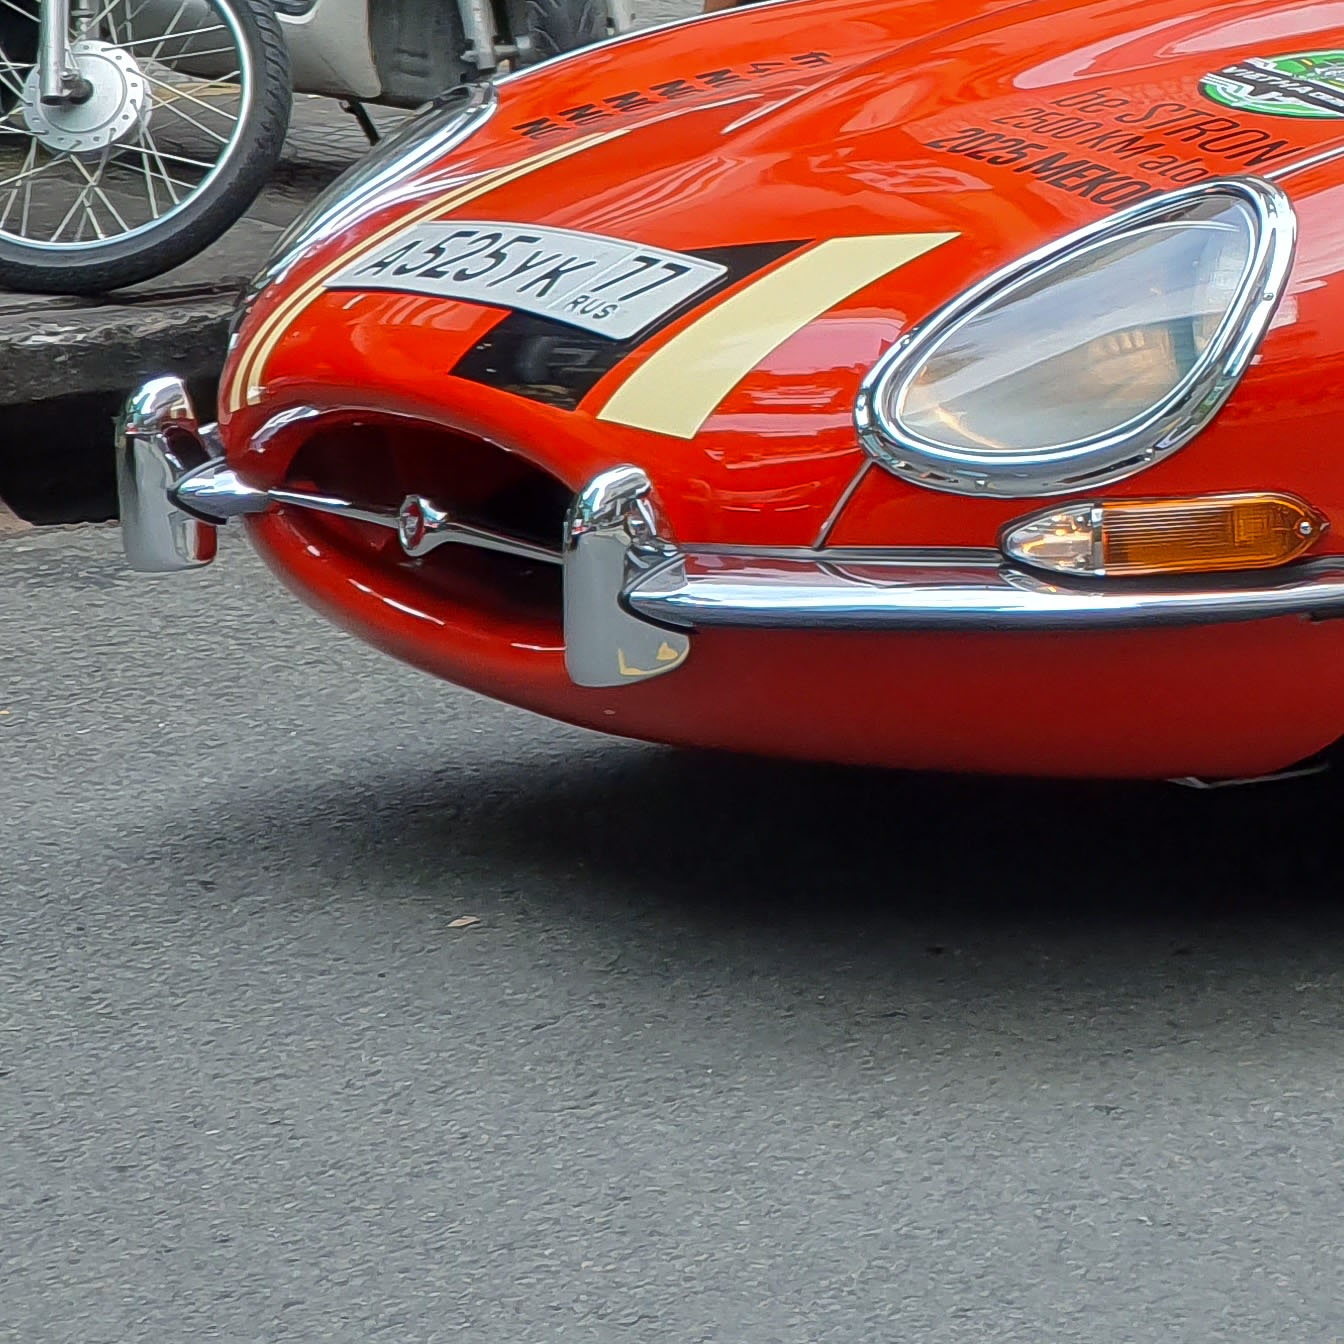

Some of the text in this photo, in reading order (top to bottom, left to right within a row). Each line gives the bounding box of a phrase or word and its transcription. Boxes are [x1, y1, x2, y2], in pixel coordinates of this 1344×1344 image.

[1049, 87, 1130, 113] be
[925, 127, 1048, 166] 2025
[991, 107, 1101, 140] 2500
[1078, 129, 1165, 159] KM
[591, 255, 693, 302] 77
[564, 294, 619, 320] RUS
